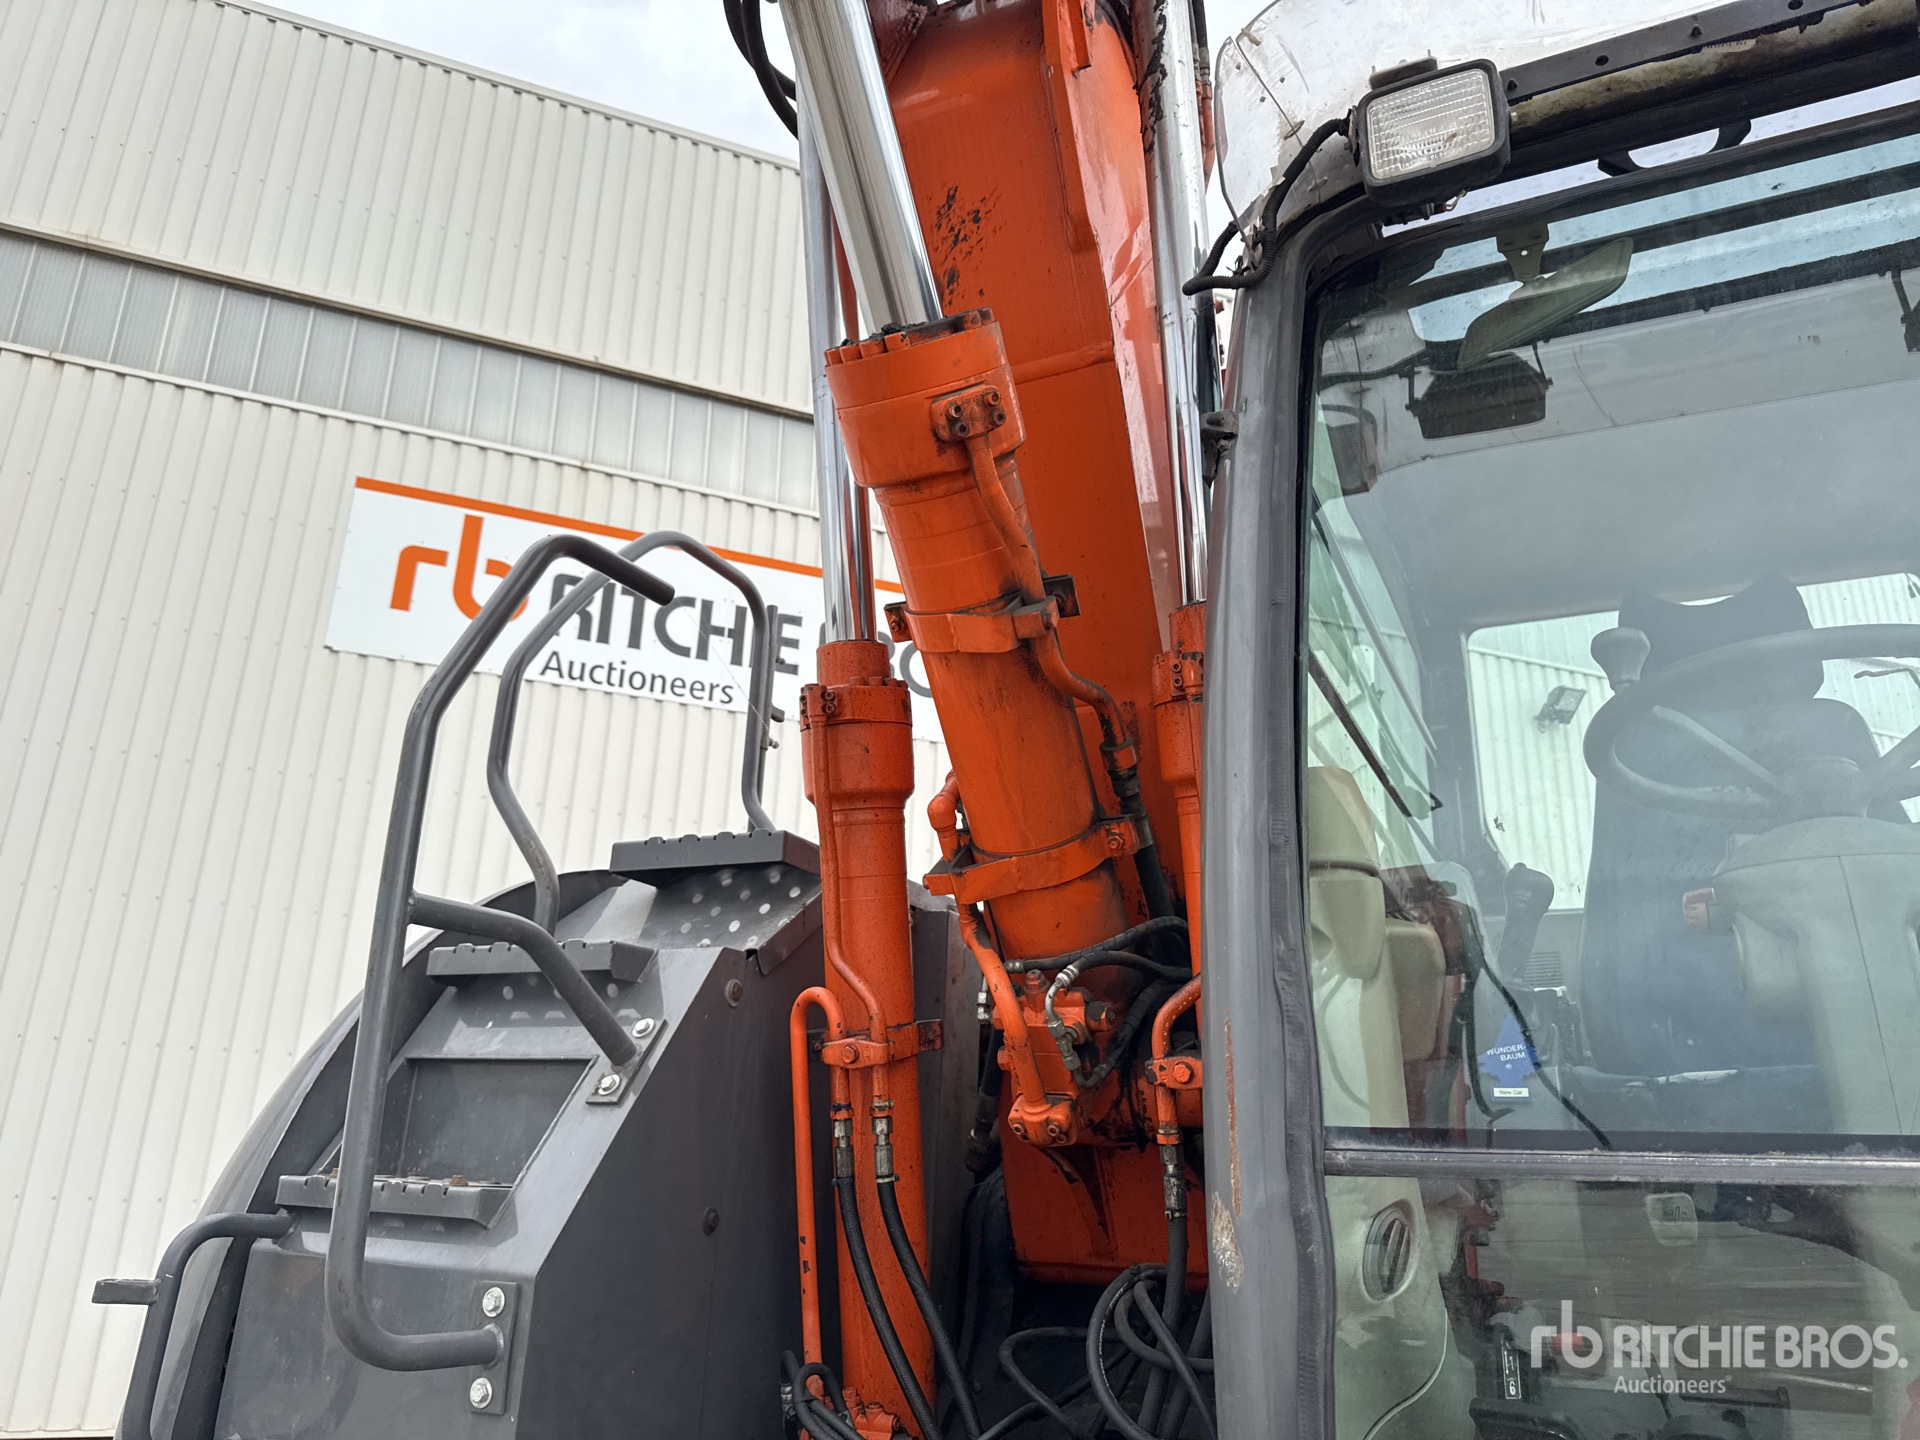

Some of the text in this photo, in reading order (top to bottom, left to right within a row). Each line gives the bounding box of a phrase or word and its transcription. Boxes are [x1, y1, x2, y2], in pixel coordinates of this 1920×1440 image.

[550, 573, 803, 676] RITCHE
[539, 650, 734, 705] Auctioneers
[1486, 1044, 1527, 1056] WUNDER-
[1500, 1051, 1526, 1061] BAUM
